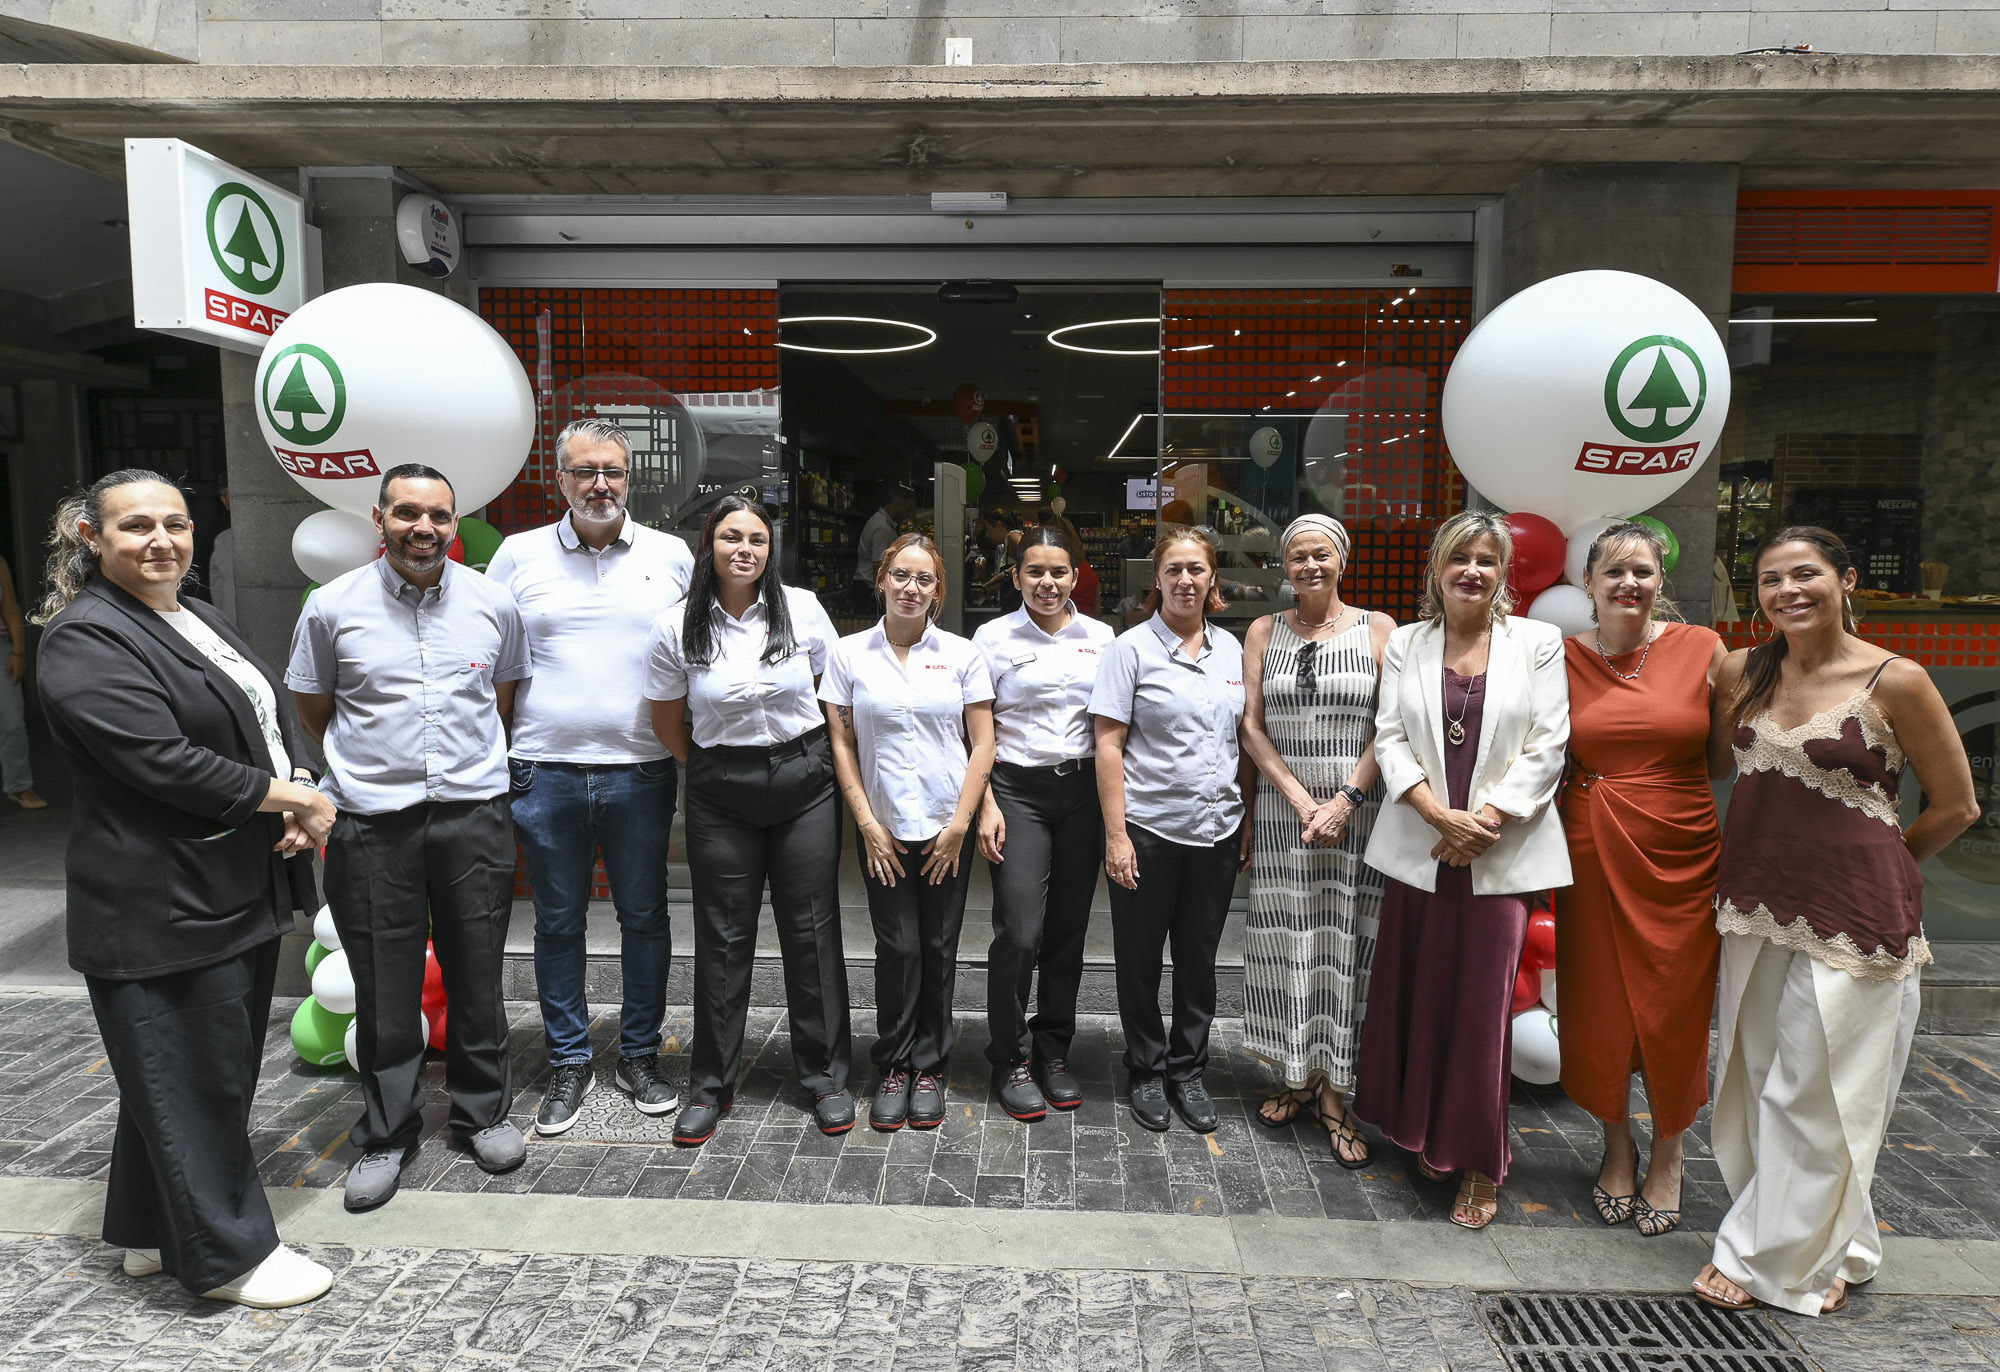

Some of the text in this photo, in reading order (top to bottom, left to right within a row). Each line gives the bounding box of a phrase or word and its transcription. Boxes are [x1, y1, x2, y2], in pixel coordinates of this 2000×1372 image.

[278, 451, 374, 475] SPAR
[1582, 447, 1694, 471] SPAR
[1986, 811, 2000, 826] C
